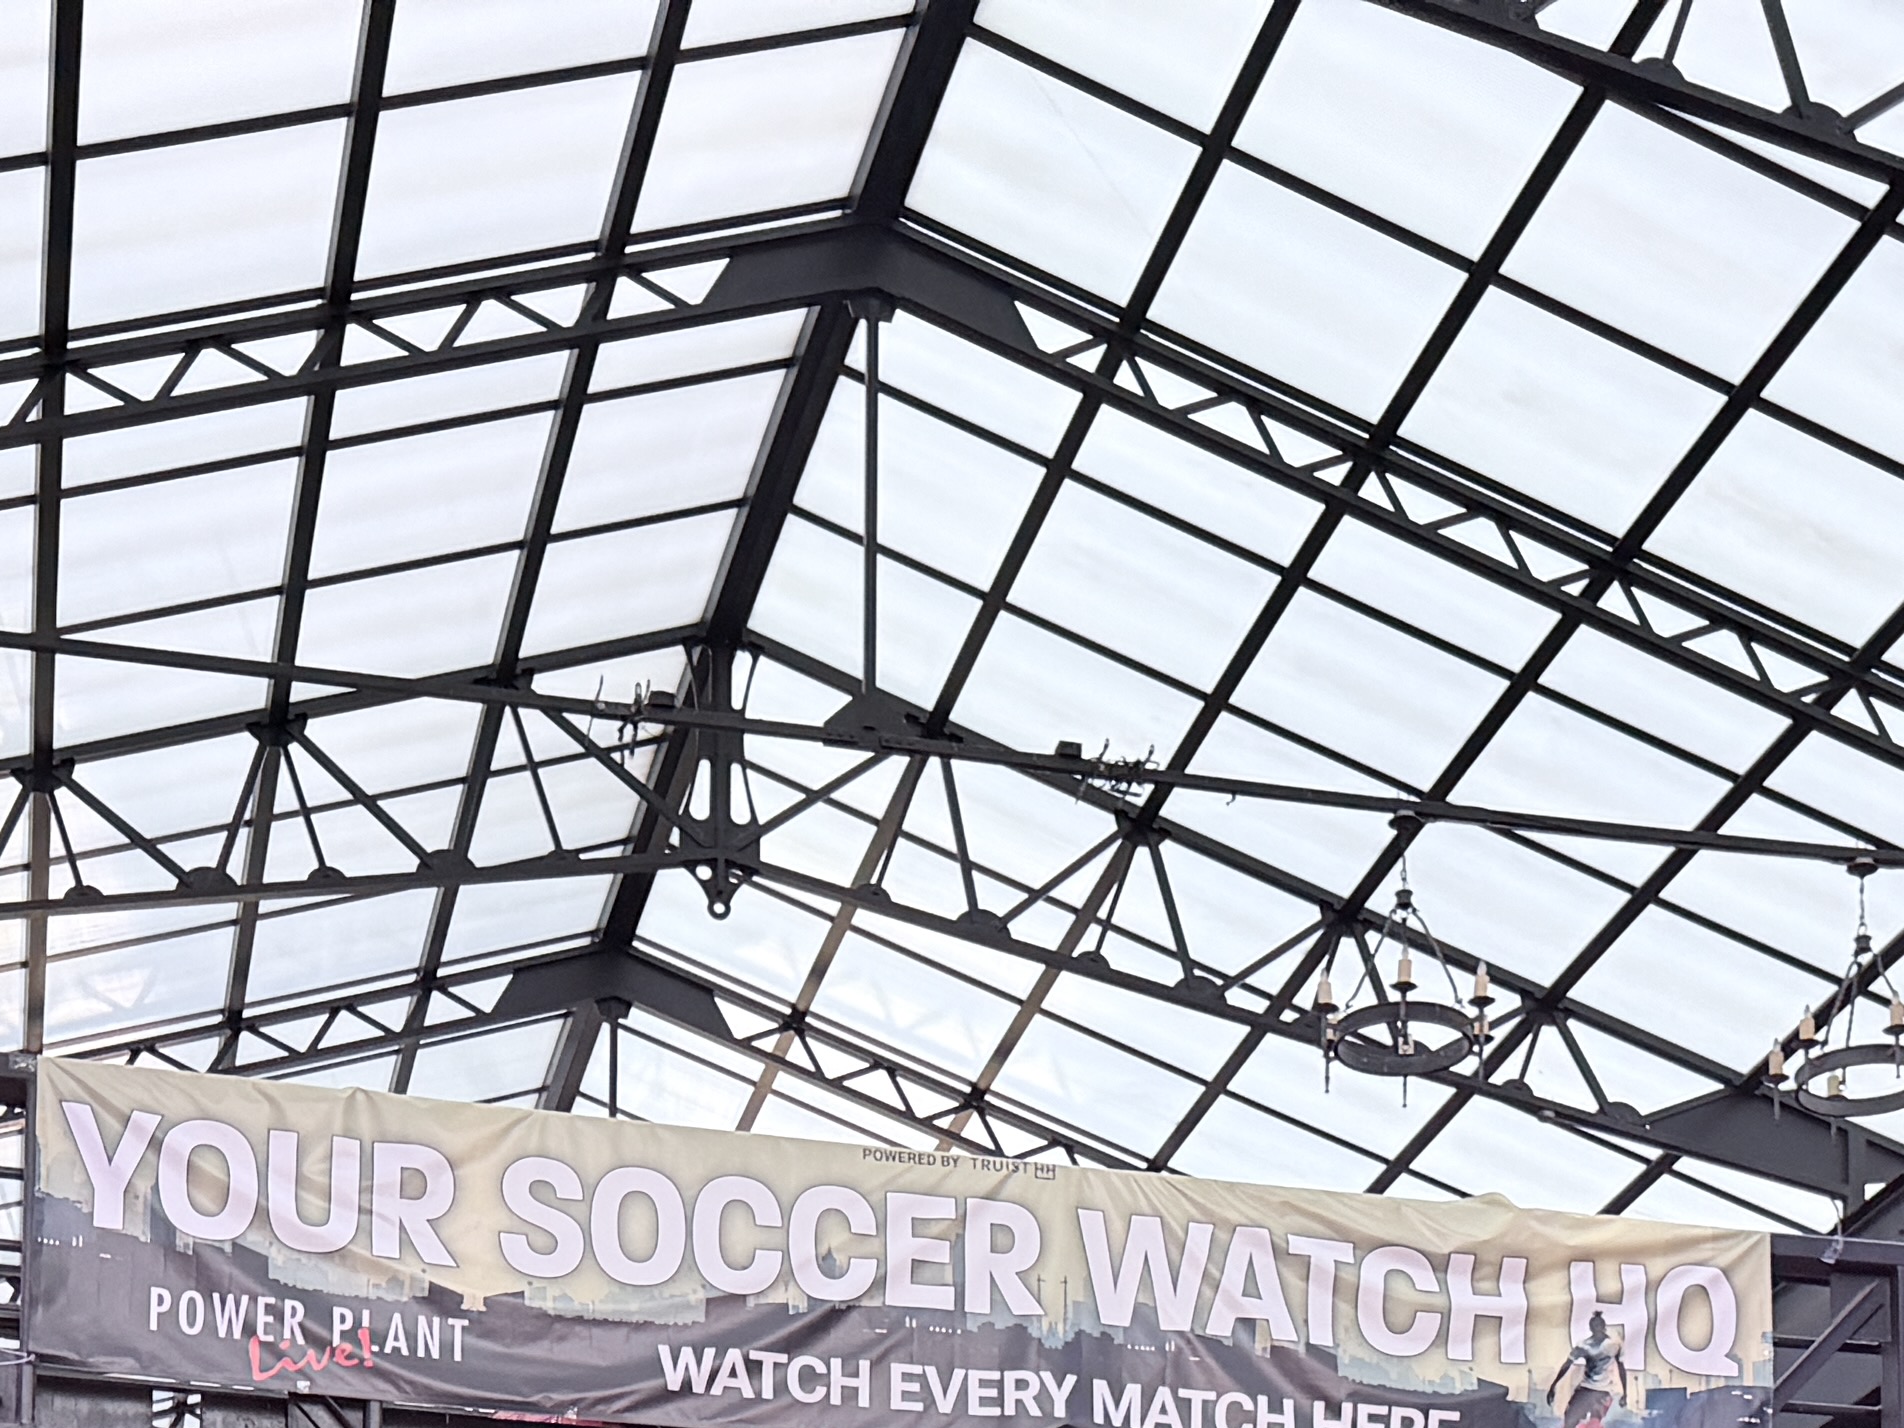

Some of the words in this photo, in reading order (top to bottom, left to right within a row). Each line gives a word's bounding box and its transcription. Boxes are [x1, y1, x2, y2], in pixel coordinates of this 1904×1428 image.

[862, 1148, 936, 1167] POWERED
[941, 1155, 960, 1169] BY
[970, 1157, 1030, 1174] TRUIST
[60, 1100, 460, 1268] YOUR
[498, 1155, 1046, 1317] SOCCER
[1076, 1207, 1529, 1365] WATCH
[1567, 1260, 1741, 1378] HQ
[149, 1286, 307, 1346] POWER
[331, 1305, 471, 1362] PLANT
[247, 1326, 375, 1382] Live!
[656, 1343, 873, 1409] WATCH
[888, 1361, 1079, 1419] EVERY
